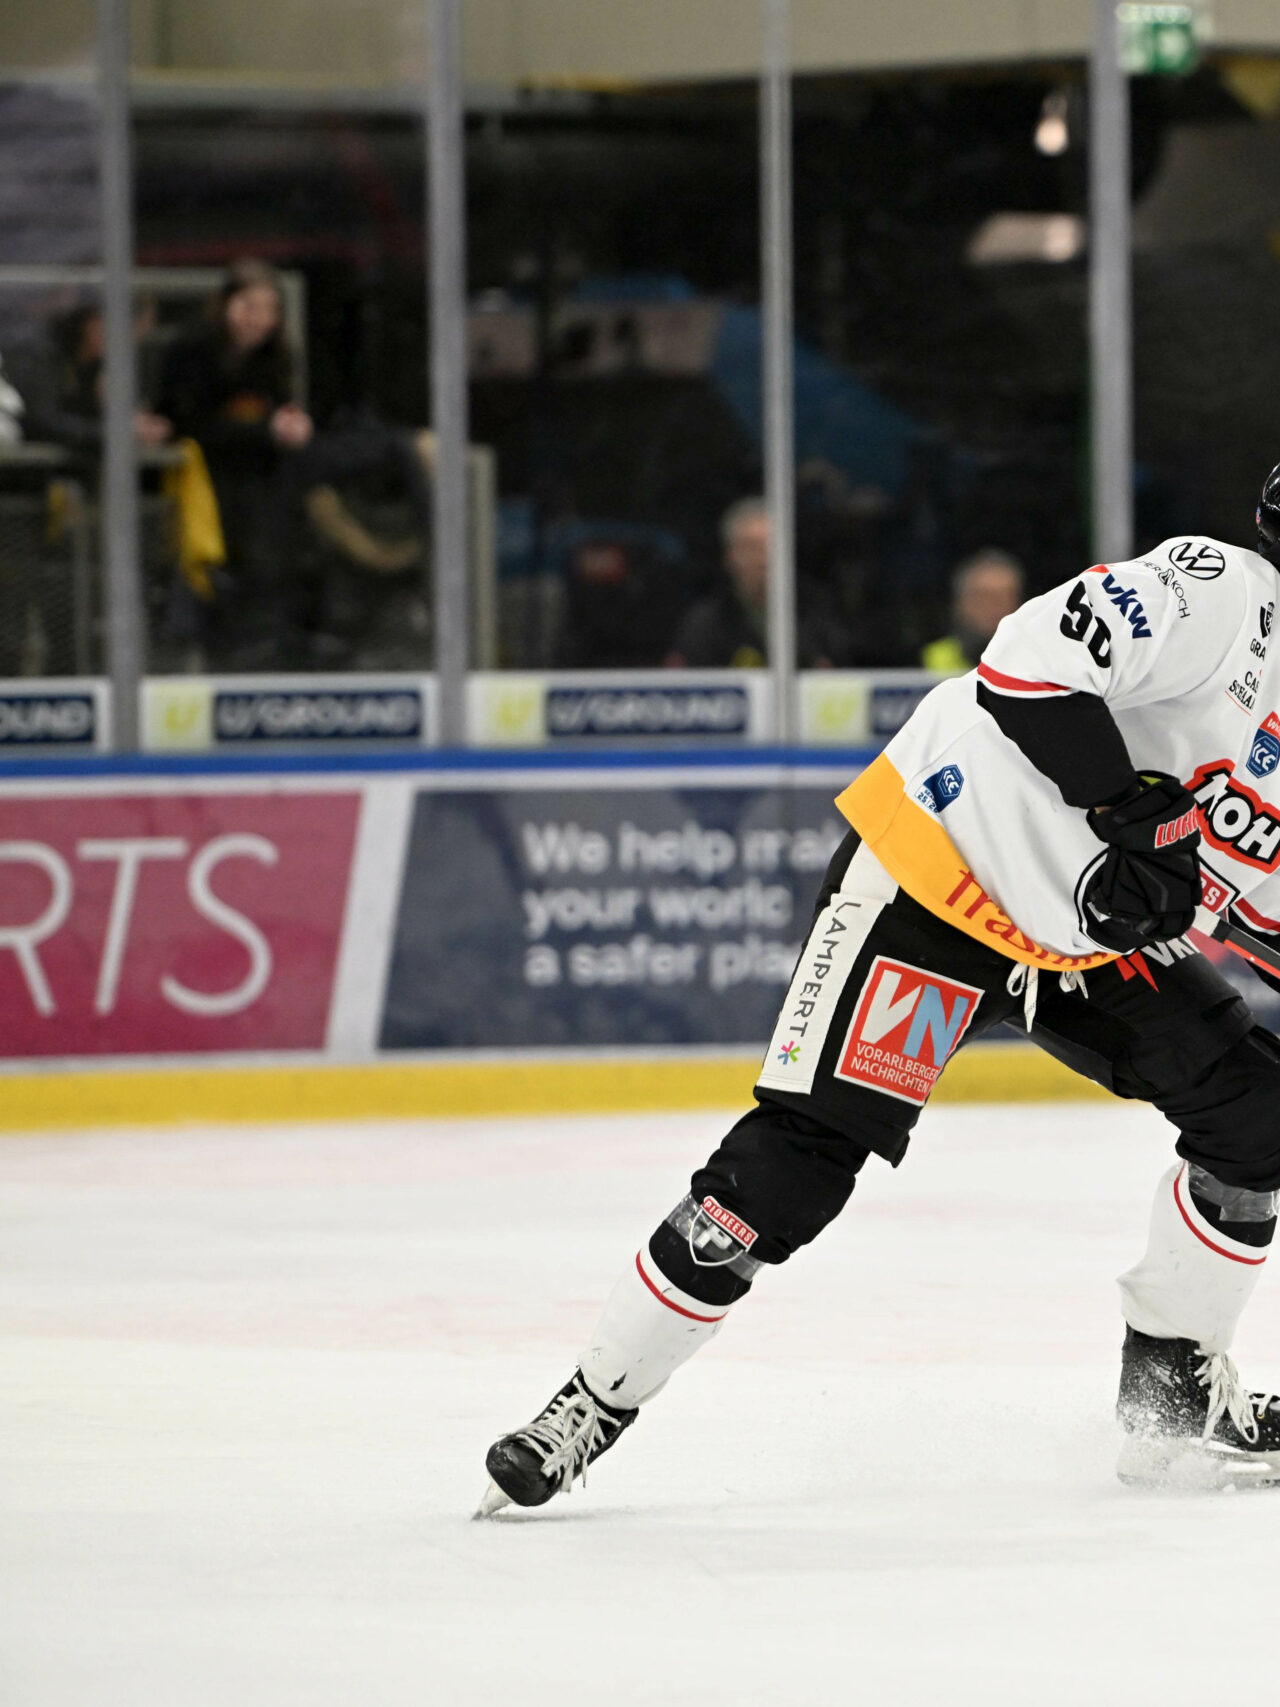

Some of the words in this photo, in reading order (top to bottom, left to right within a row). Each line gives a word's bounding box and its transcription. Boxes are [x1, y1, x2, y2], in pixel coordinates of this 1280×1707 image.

[1060, 580, 1112, 669] 50
[522, 820, 612, 875] We
[617, 820, 738, 879] help
[522, 886, 641, 940] your
[523, 943, 563, 987] a
[789, 901, 862, 1038] LAMPERT
[859, 969, 970, 1068] VN
[850, 1057, 931, 1094] NACHRICHTEN
[856, 1042, 940, 1081] VORARLBERGER
[703, 1199, 754, 1243] PIONEERS
